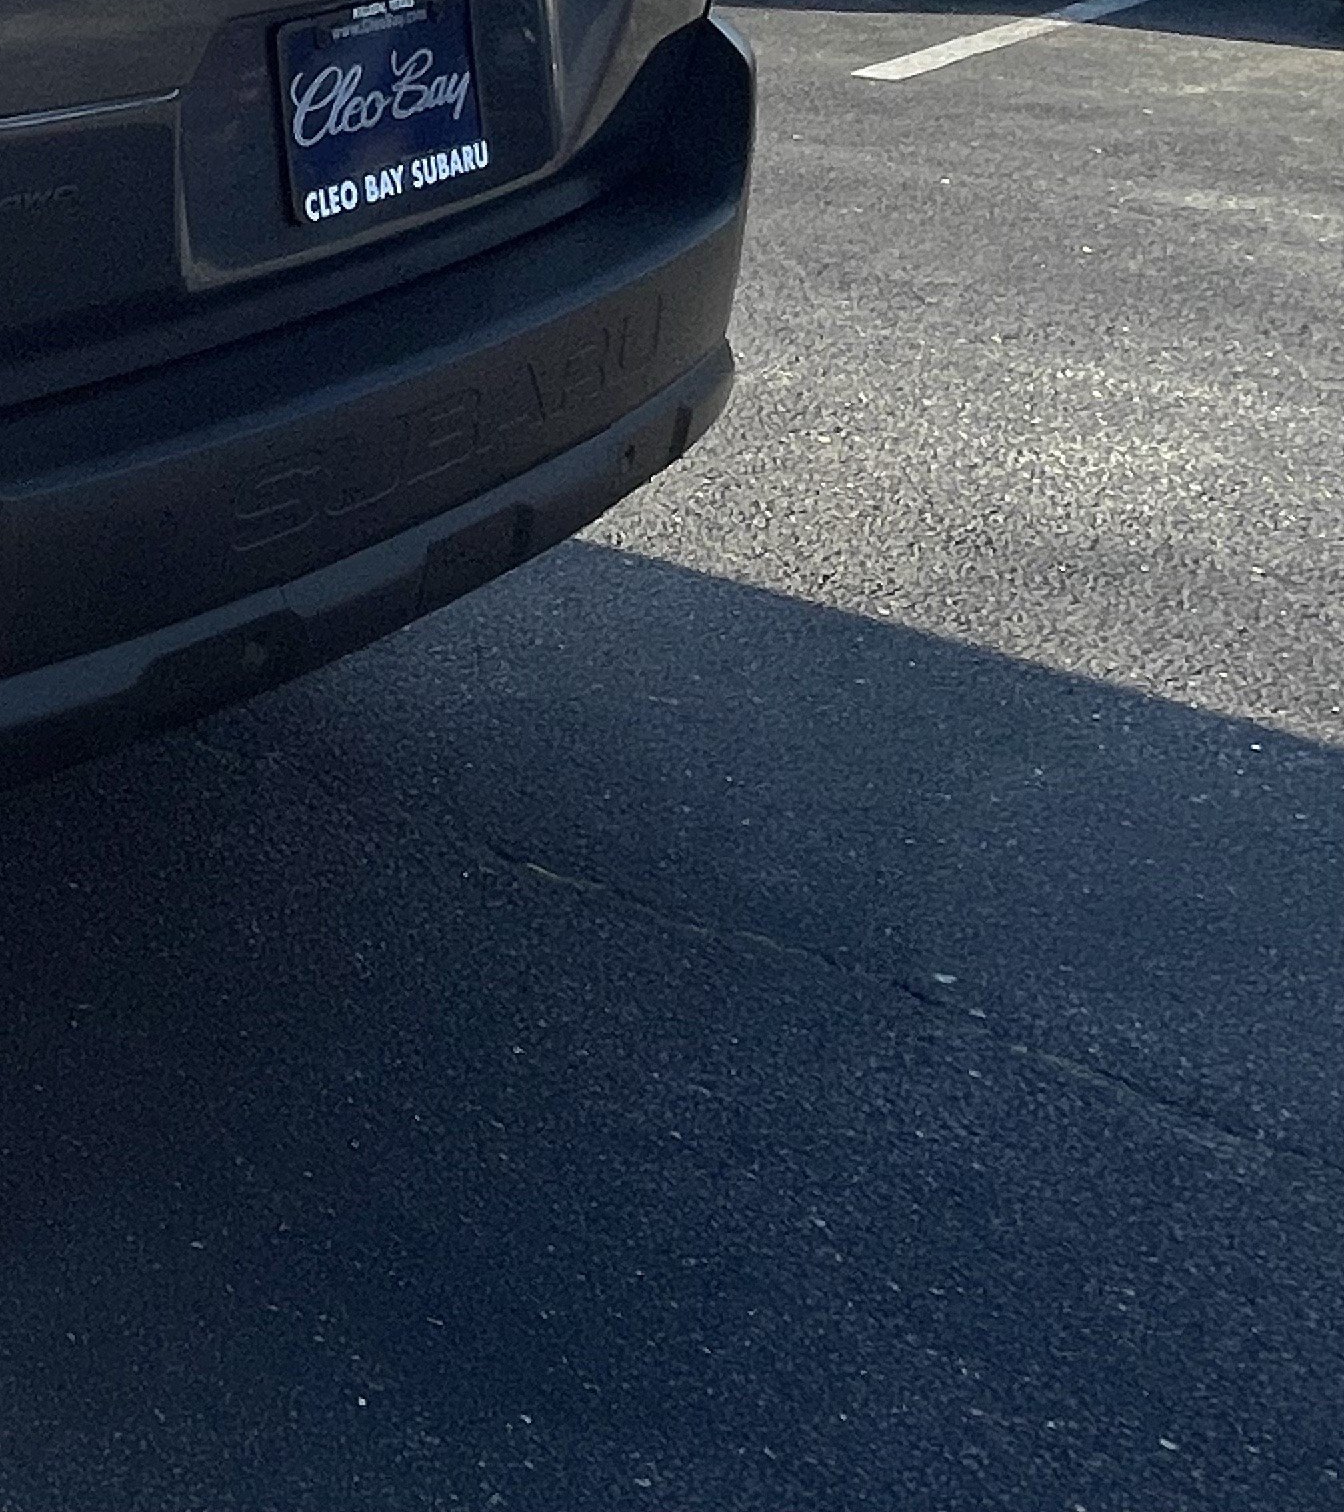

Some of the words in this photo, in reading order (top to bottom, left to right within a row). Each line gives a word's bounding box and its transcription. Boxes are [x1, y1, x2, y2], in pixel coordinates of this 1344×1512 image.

[290, 64, 391, 148] Cleo
[391, 47, 471, 120] Bay
[304, 179, 358, 221] CLEO
[364, 163, 405, 203] BAY
[412, 140, 490, 189] SUBARU
[231, 292, 664, 553] SUBARU
